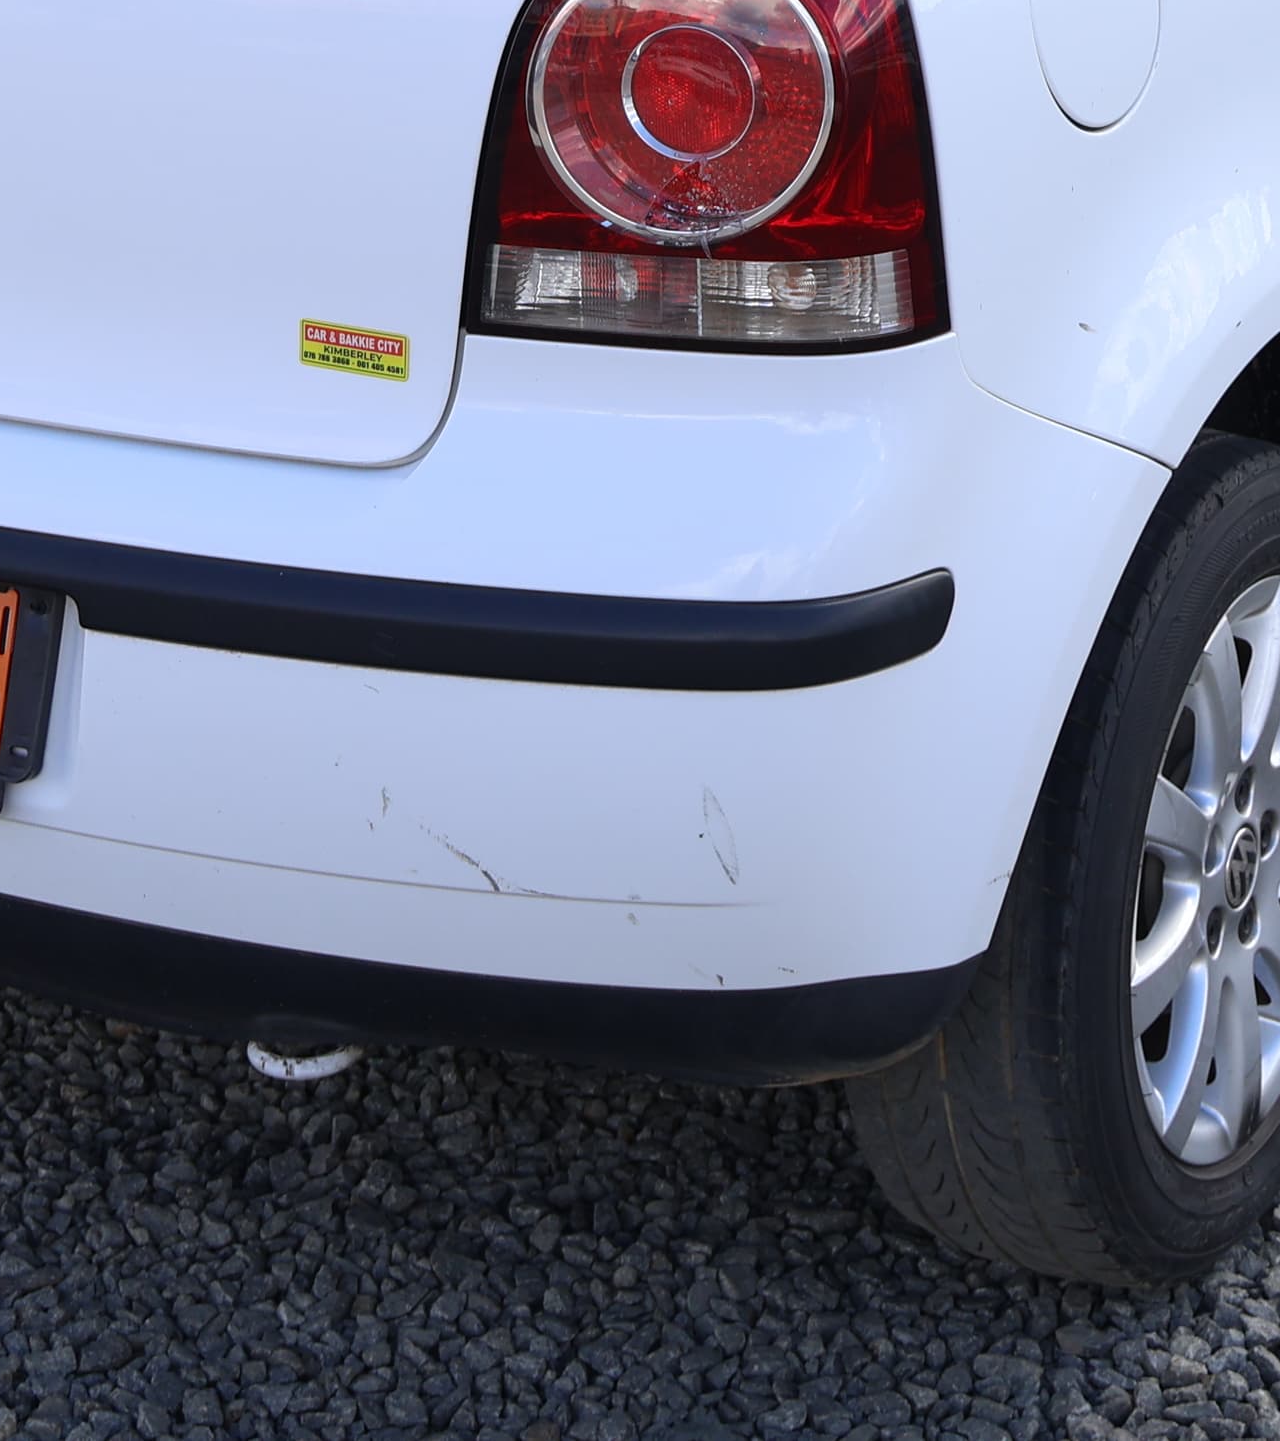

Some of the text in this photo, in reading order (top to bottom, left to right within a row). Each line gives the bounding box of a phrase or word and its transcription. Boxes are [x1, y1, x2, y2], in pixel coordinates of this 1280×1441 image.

[306, 327, 401, 354] CAR & BAKKIE CITY
[323, 345, 383, 362] KIMBERLEY
